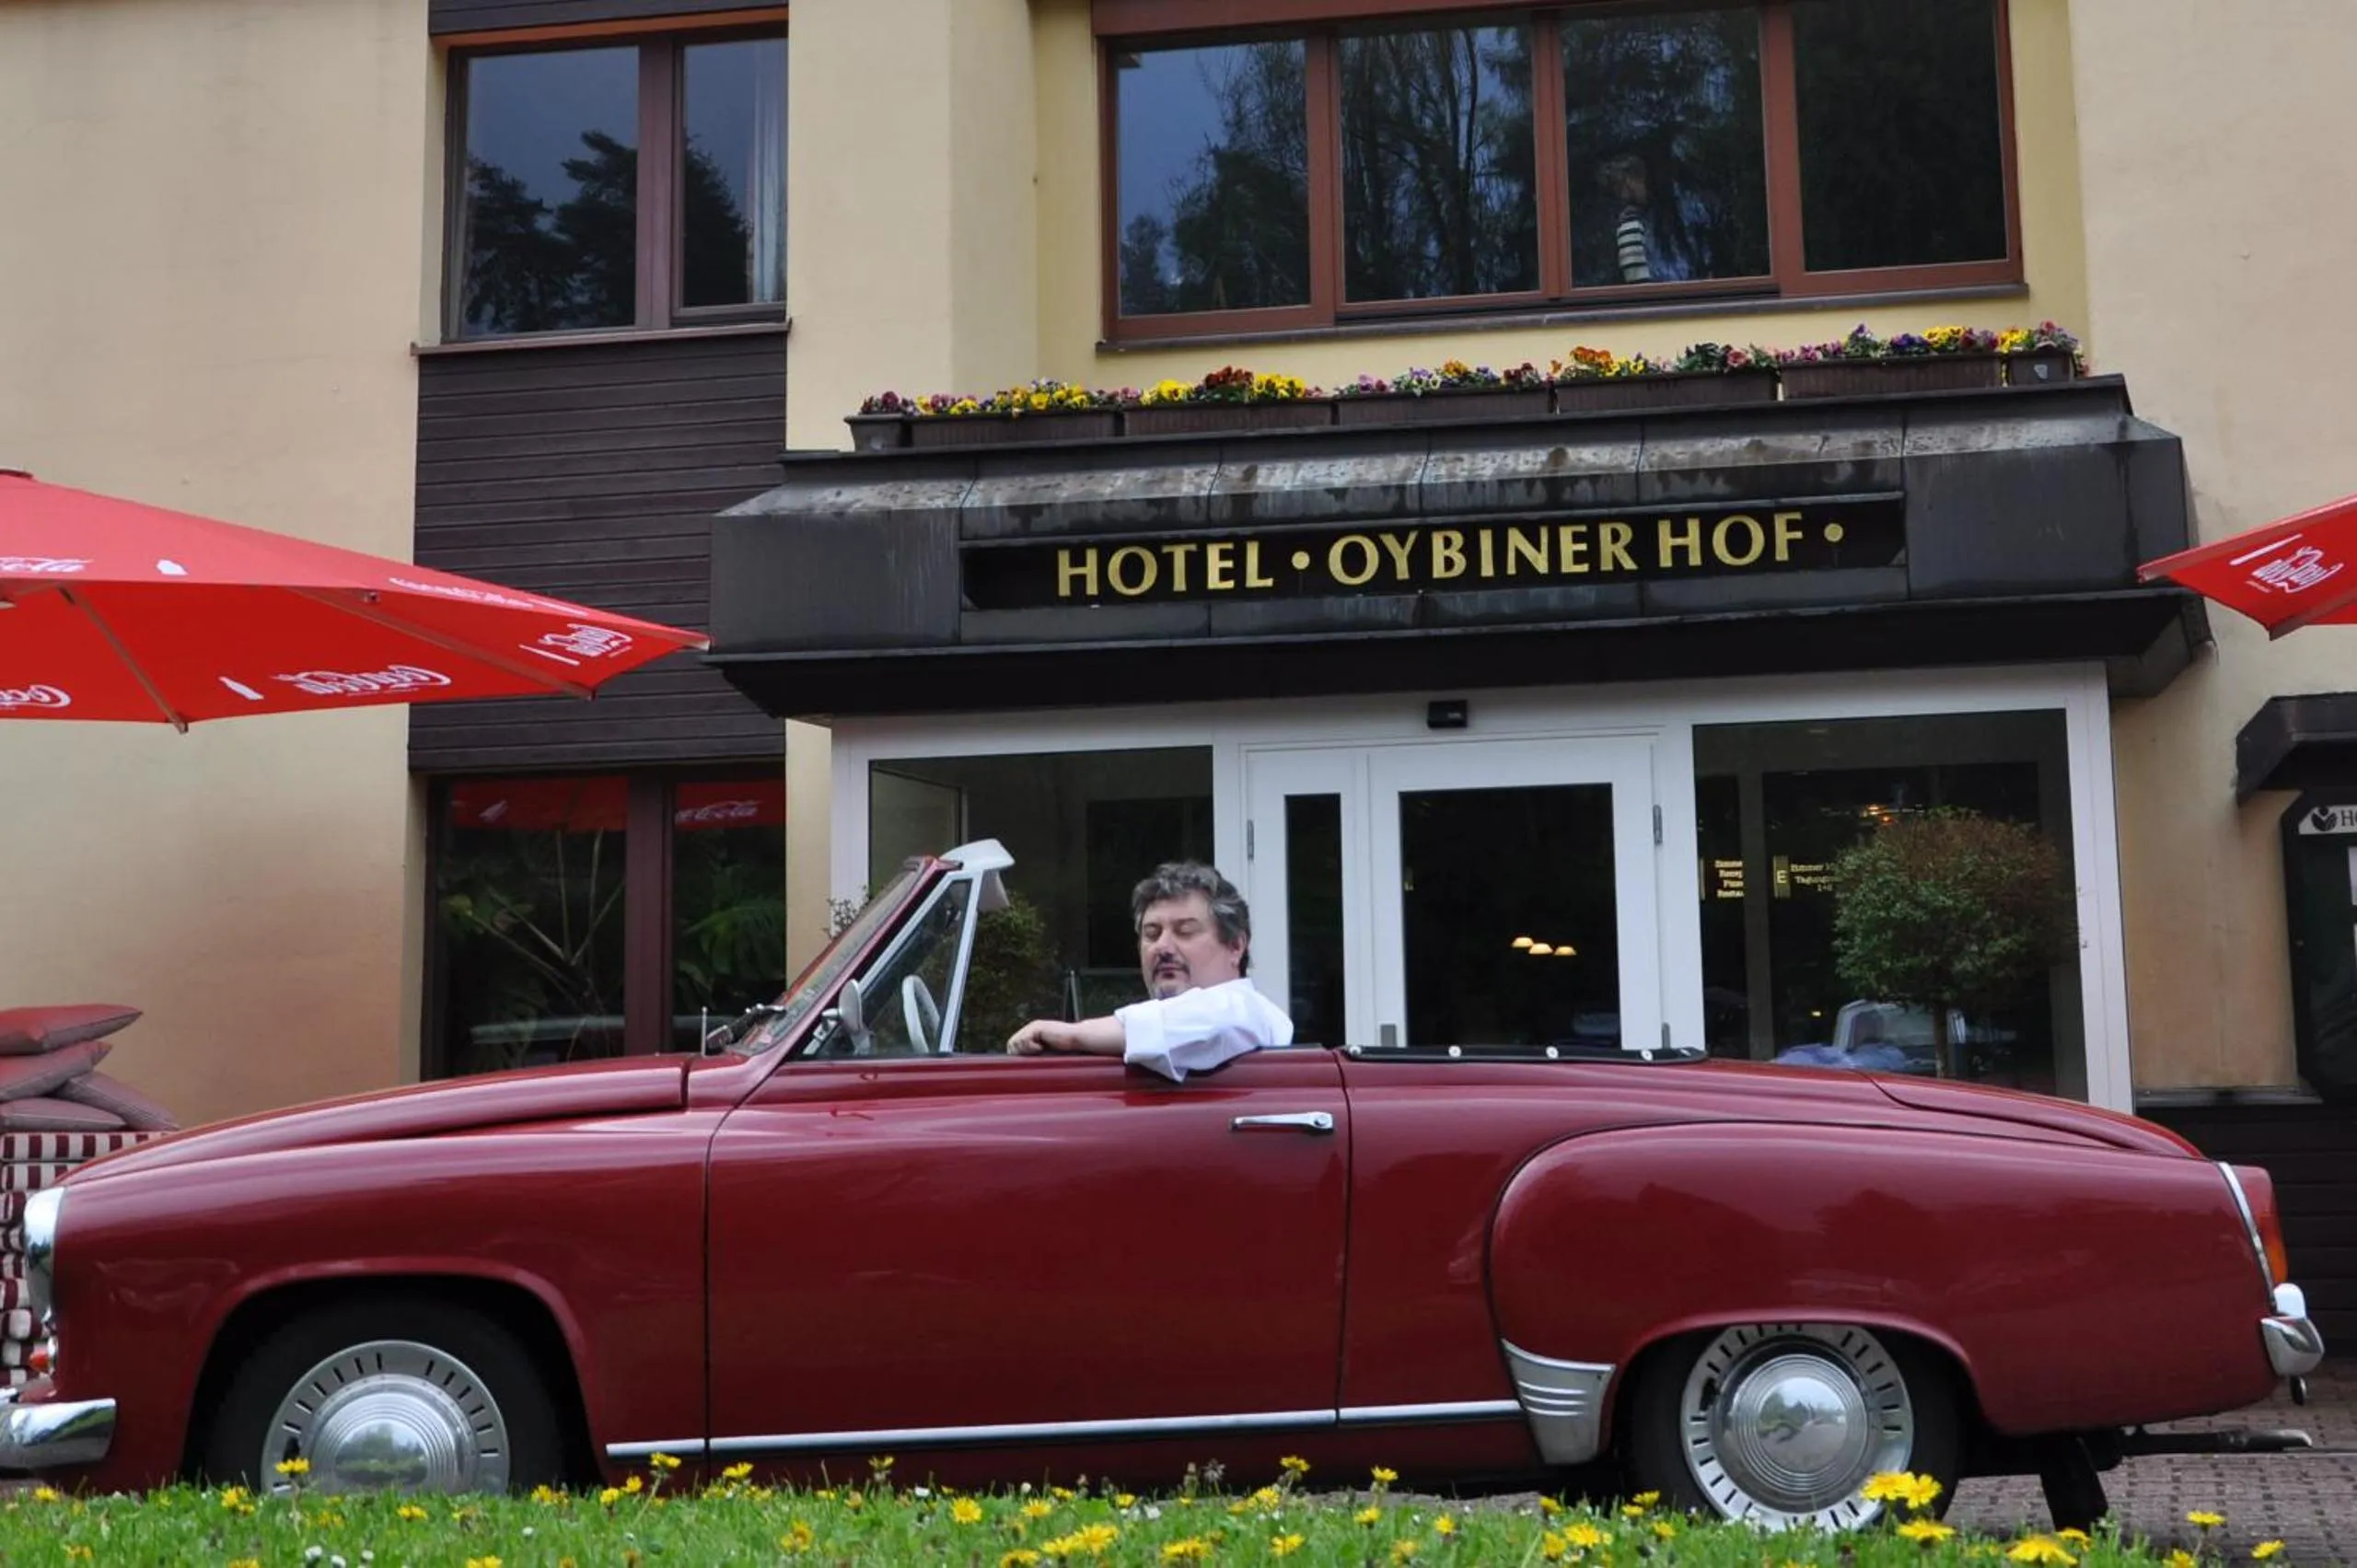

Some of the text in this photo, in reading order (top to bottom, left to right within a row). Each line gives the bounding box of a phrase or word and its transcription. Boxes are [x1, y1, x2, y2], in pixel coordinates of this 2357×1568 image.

[1057, 511, 1805, 598] HOTEL OYBINER HOF
